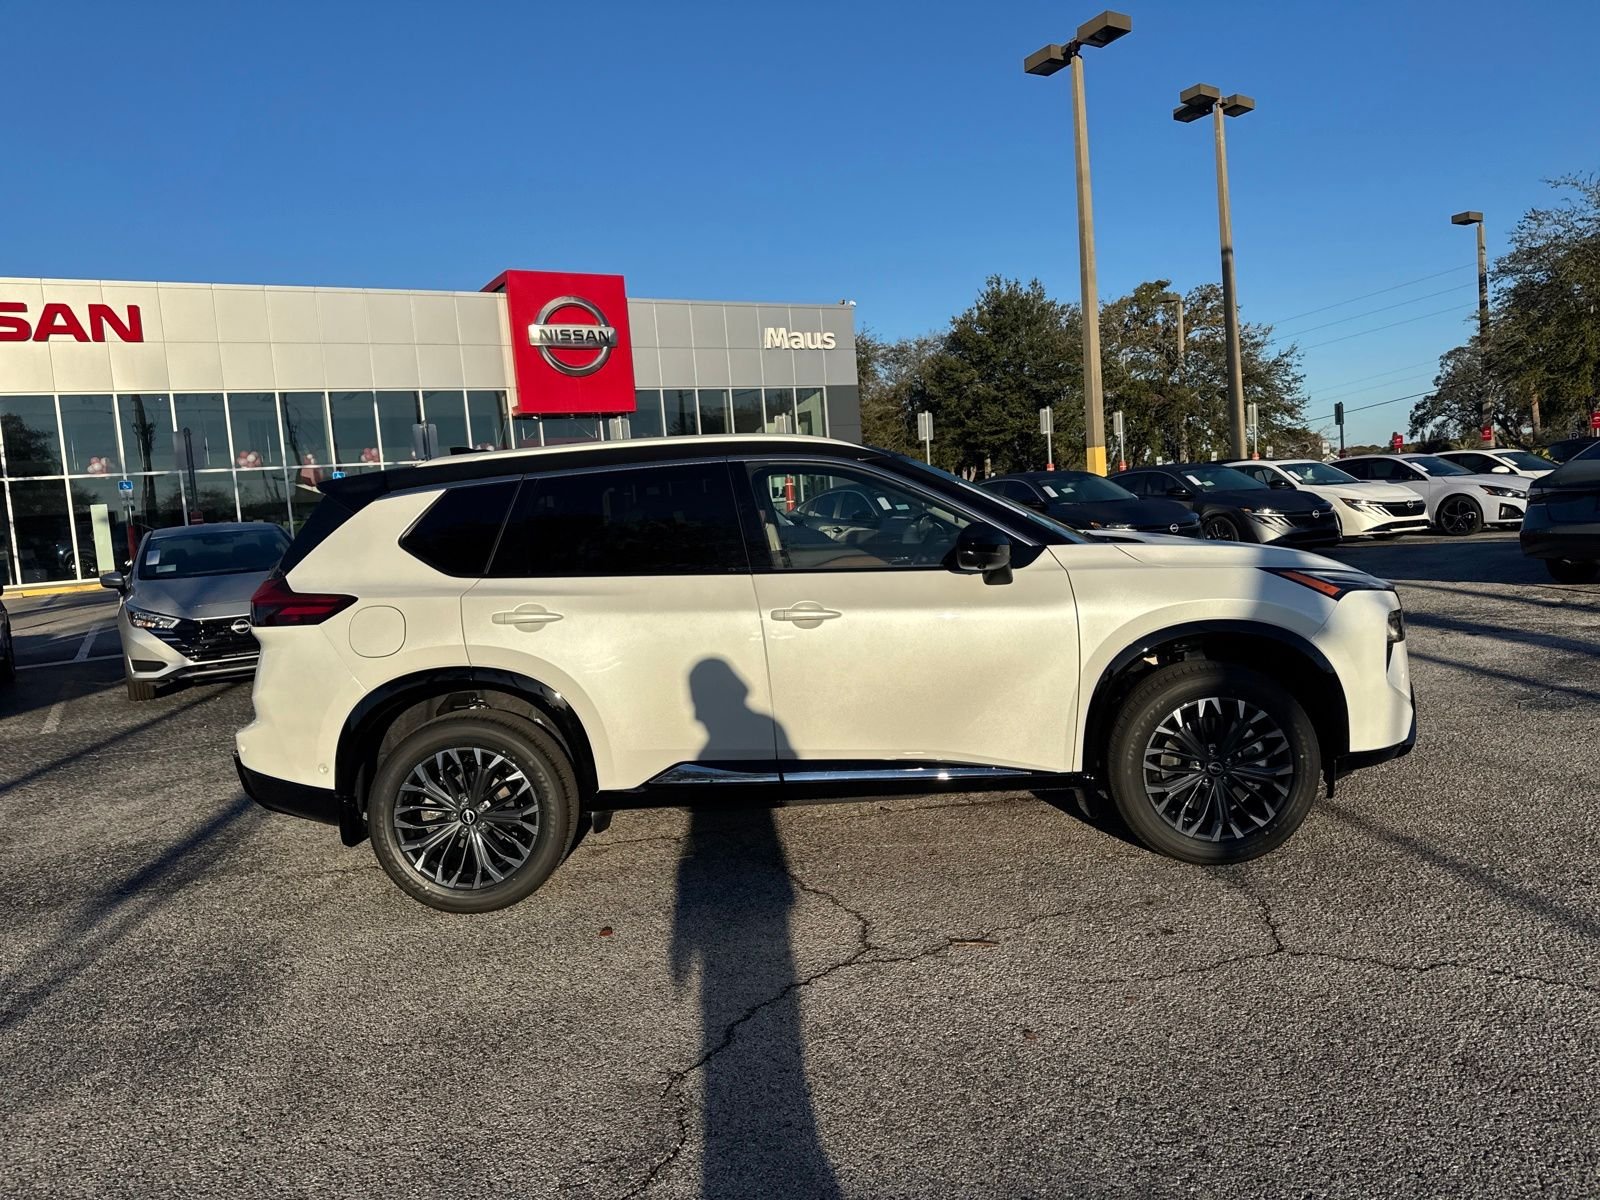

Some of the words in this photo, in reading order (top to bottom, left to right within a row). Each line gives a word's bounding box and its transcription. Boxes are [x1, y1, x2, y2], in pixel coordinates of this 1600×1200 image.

[0, 302, 144, 343] SAN
[539, 328, 611, 344] NISSAN
[764, 327, 837, 350] Maus
